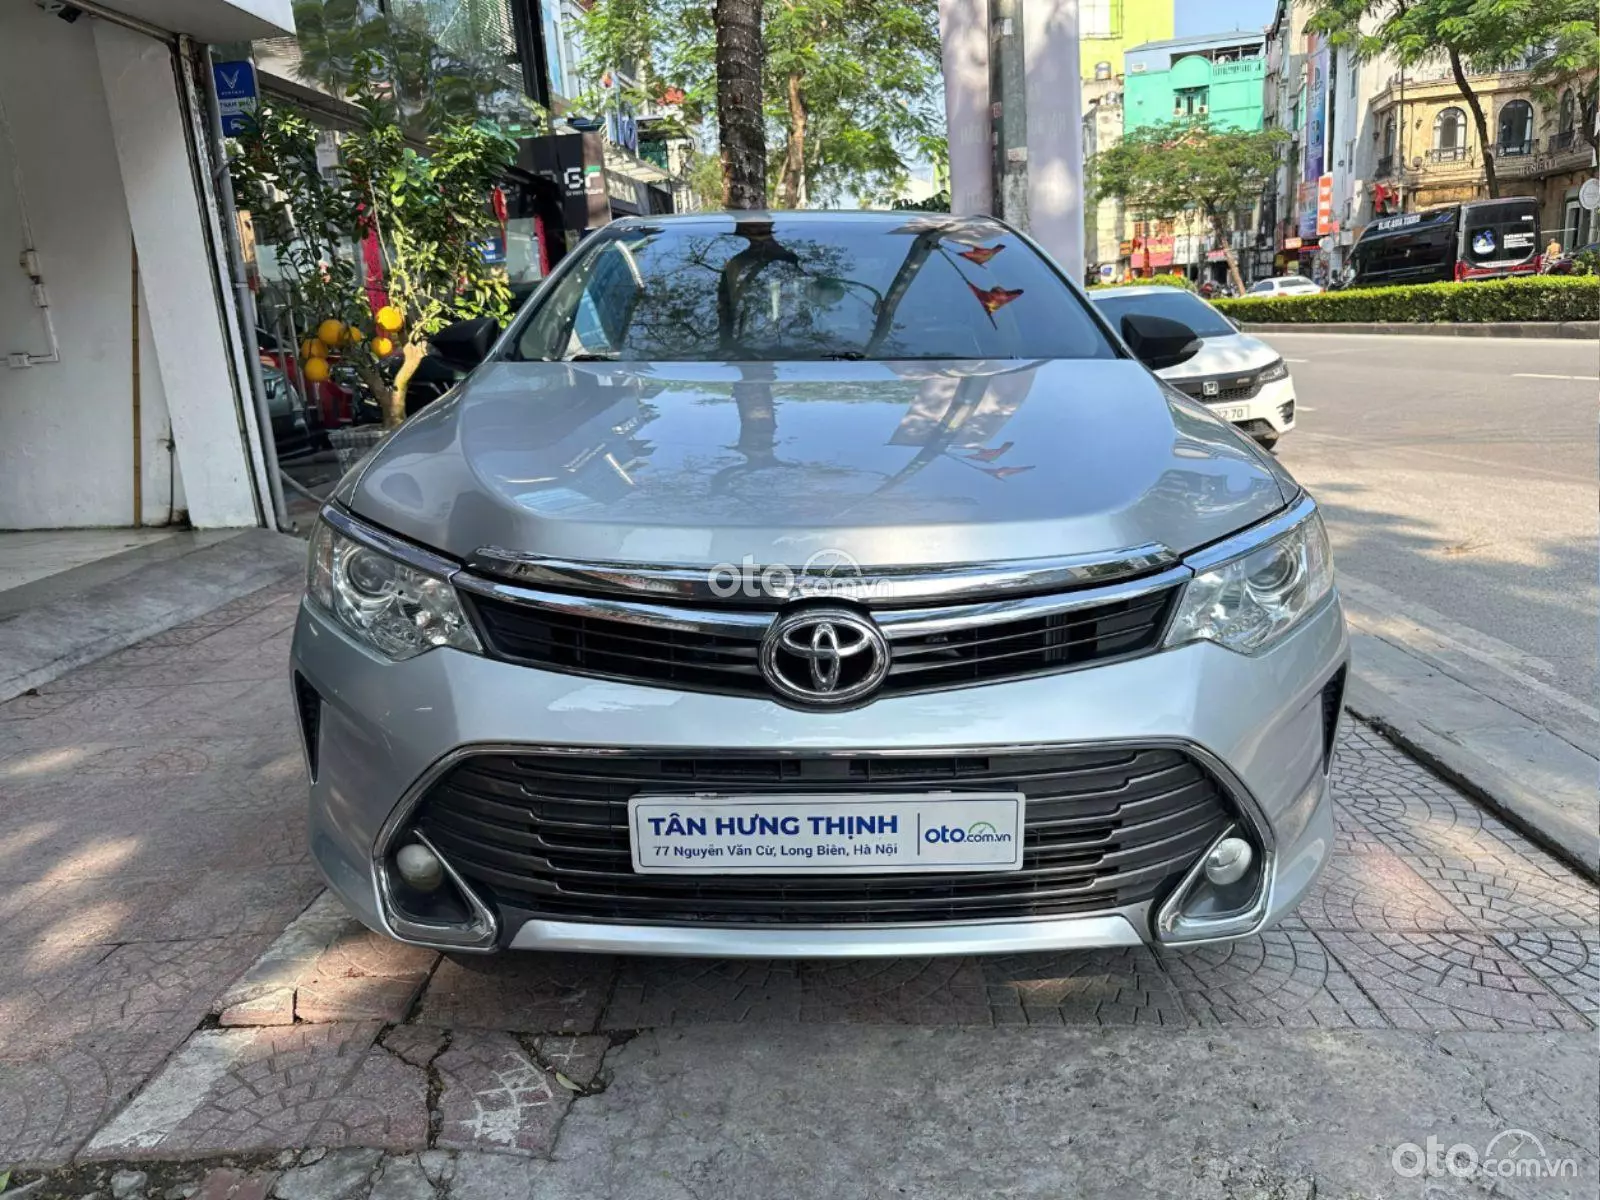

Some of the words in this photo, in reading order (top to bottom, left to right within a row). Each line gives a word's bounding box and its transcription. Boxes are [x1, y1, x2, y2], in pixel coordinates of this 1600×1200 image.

[648, 813, 707, 836] TÂN
[716, 813, 800, 836] HƯNG
[807, 815, 898, 840] THỊNH
[924, 825, 1011, 844] oto.com.vn
[655, 845, 670, 857] 77
[727, 845, 752, 857] Văn
[781, 845, 813, 859] Long
[817, 844, 850, 858] Biên,
[854, 843, 871, 856] Hà
[875, 843, 898, 857] Nội
